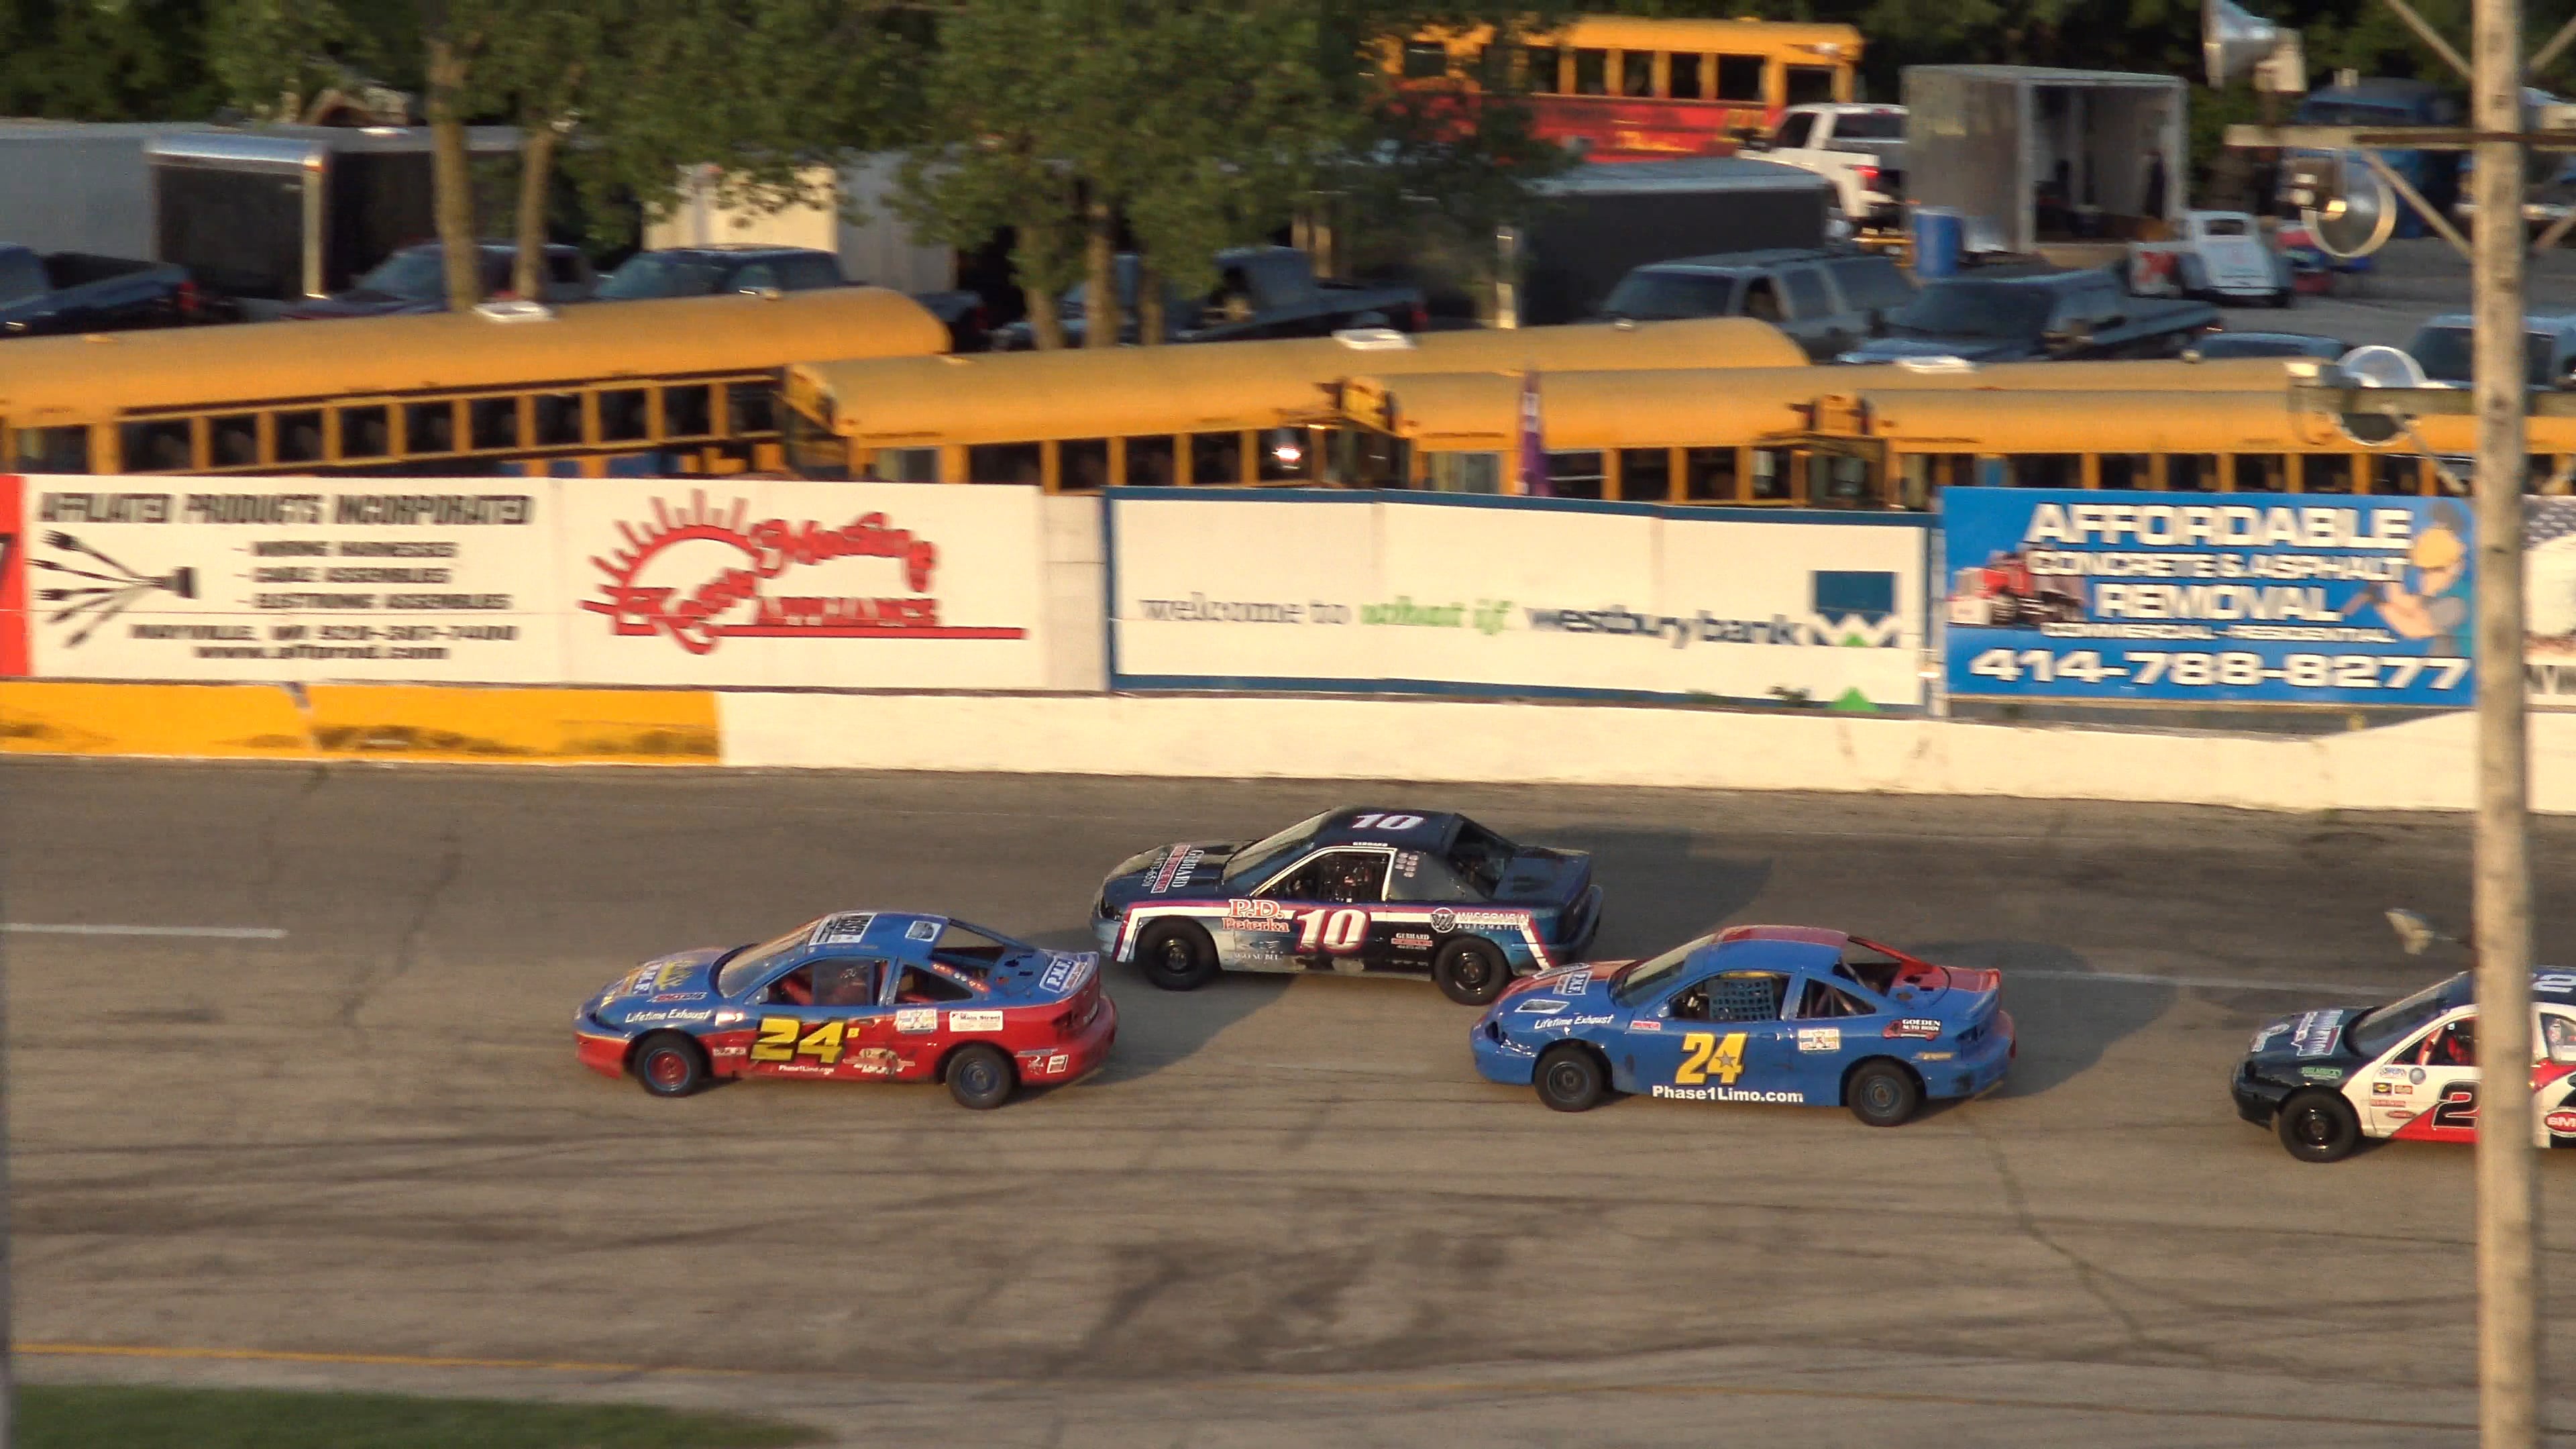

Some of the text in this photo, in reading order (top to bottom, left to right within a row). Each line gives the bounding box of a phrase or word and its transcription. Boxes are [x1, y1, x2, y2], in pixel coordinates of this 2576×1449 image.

[334, 494, 535, 525] INCORPORATED
[2025, 502, 2414, 549] AFFORDABLE
[2026, 549, 2412, 582] CONCRETE & ASPHALT
[1139, 591, 1303, 624] welcome
[1309, 600, 1352, 625] to
[2093, 582, 2345, 623] REMOVAL
[1968, 647, 2471, 691] 414-788-8277
[1352, 813, 1424, 830] 10
[1228, 898, 1285, 920] P.D.
[1456, 912, 1529, 924] WISCONSIN
[1222, 917, 1291, 934] Peterka
[1295, 908, 1368, 952] 10
[1456, 923, 1529, 931] AUTOMATION
[624, 1008, 713, 1024] Lifetime Exhaust
[1534, 1014, 1615, 1030] Lifetime Exhaust
[749, 1016, 845, 1064] 24
[1674, 1030, 1750, 1085] 24
[1652, 1085, 1805, 1104] Phase1Limo.com
